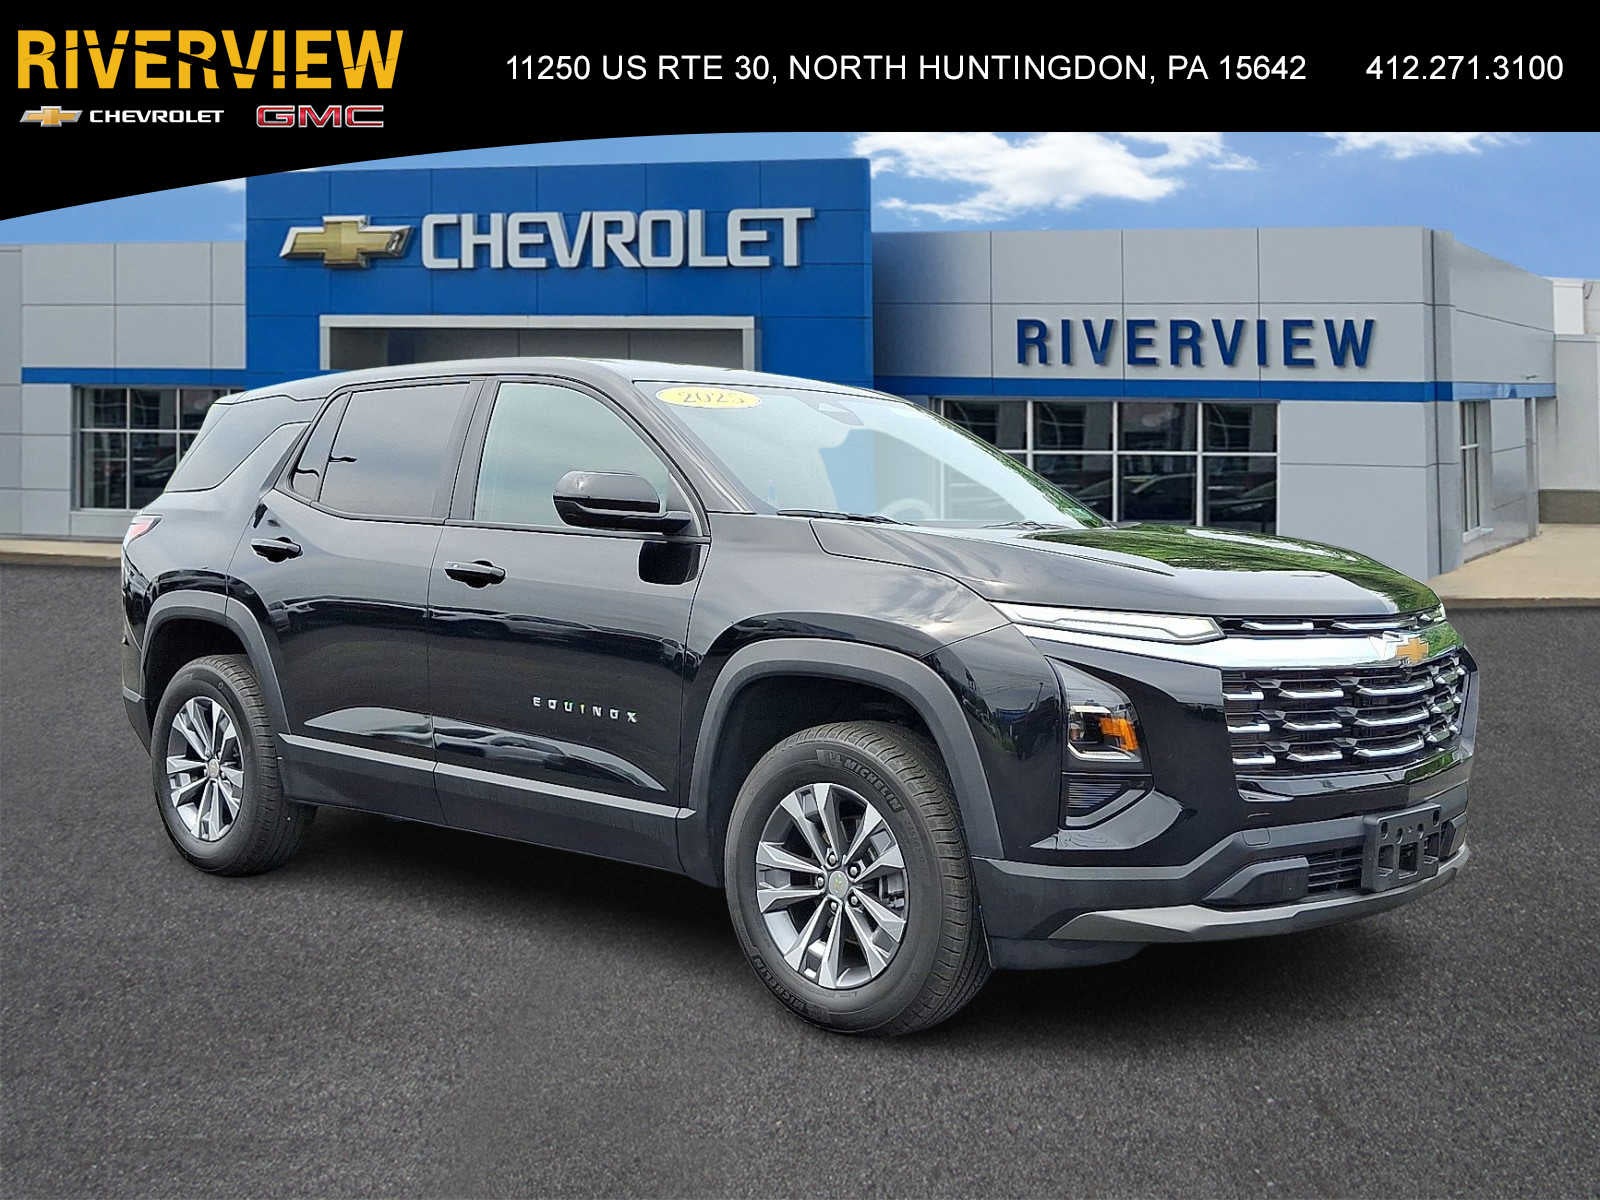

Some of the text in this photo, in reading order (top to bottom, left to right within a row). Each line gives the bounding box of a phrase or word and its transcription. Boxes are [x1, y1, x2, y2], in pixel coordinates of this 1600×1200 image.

[422, 207, 812, 270] CHEVROLET
[1016, 318, 1374, 368] RIVERVIEW
[533, 697, 638, 723] EQUINOX
